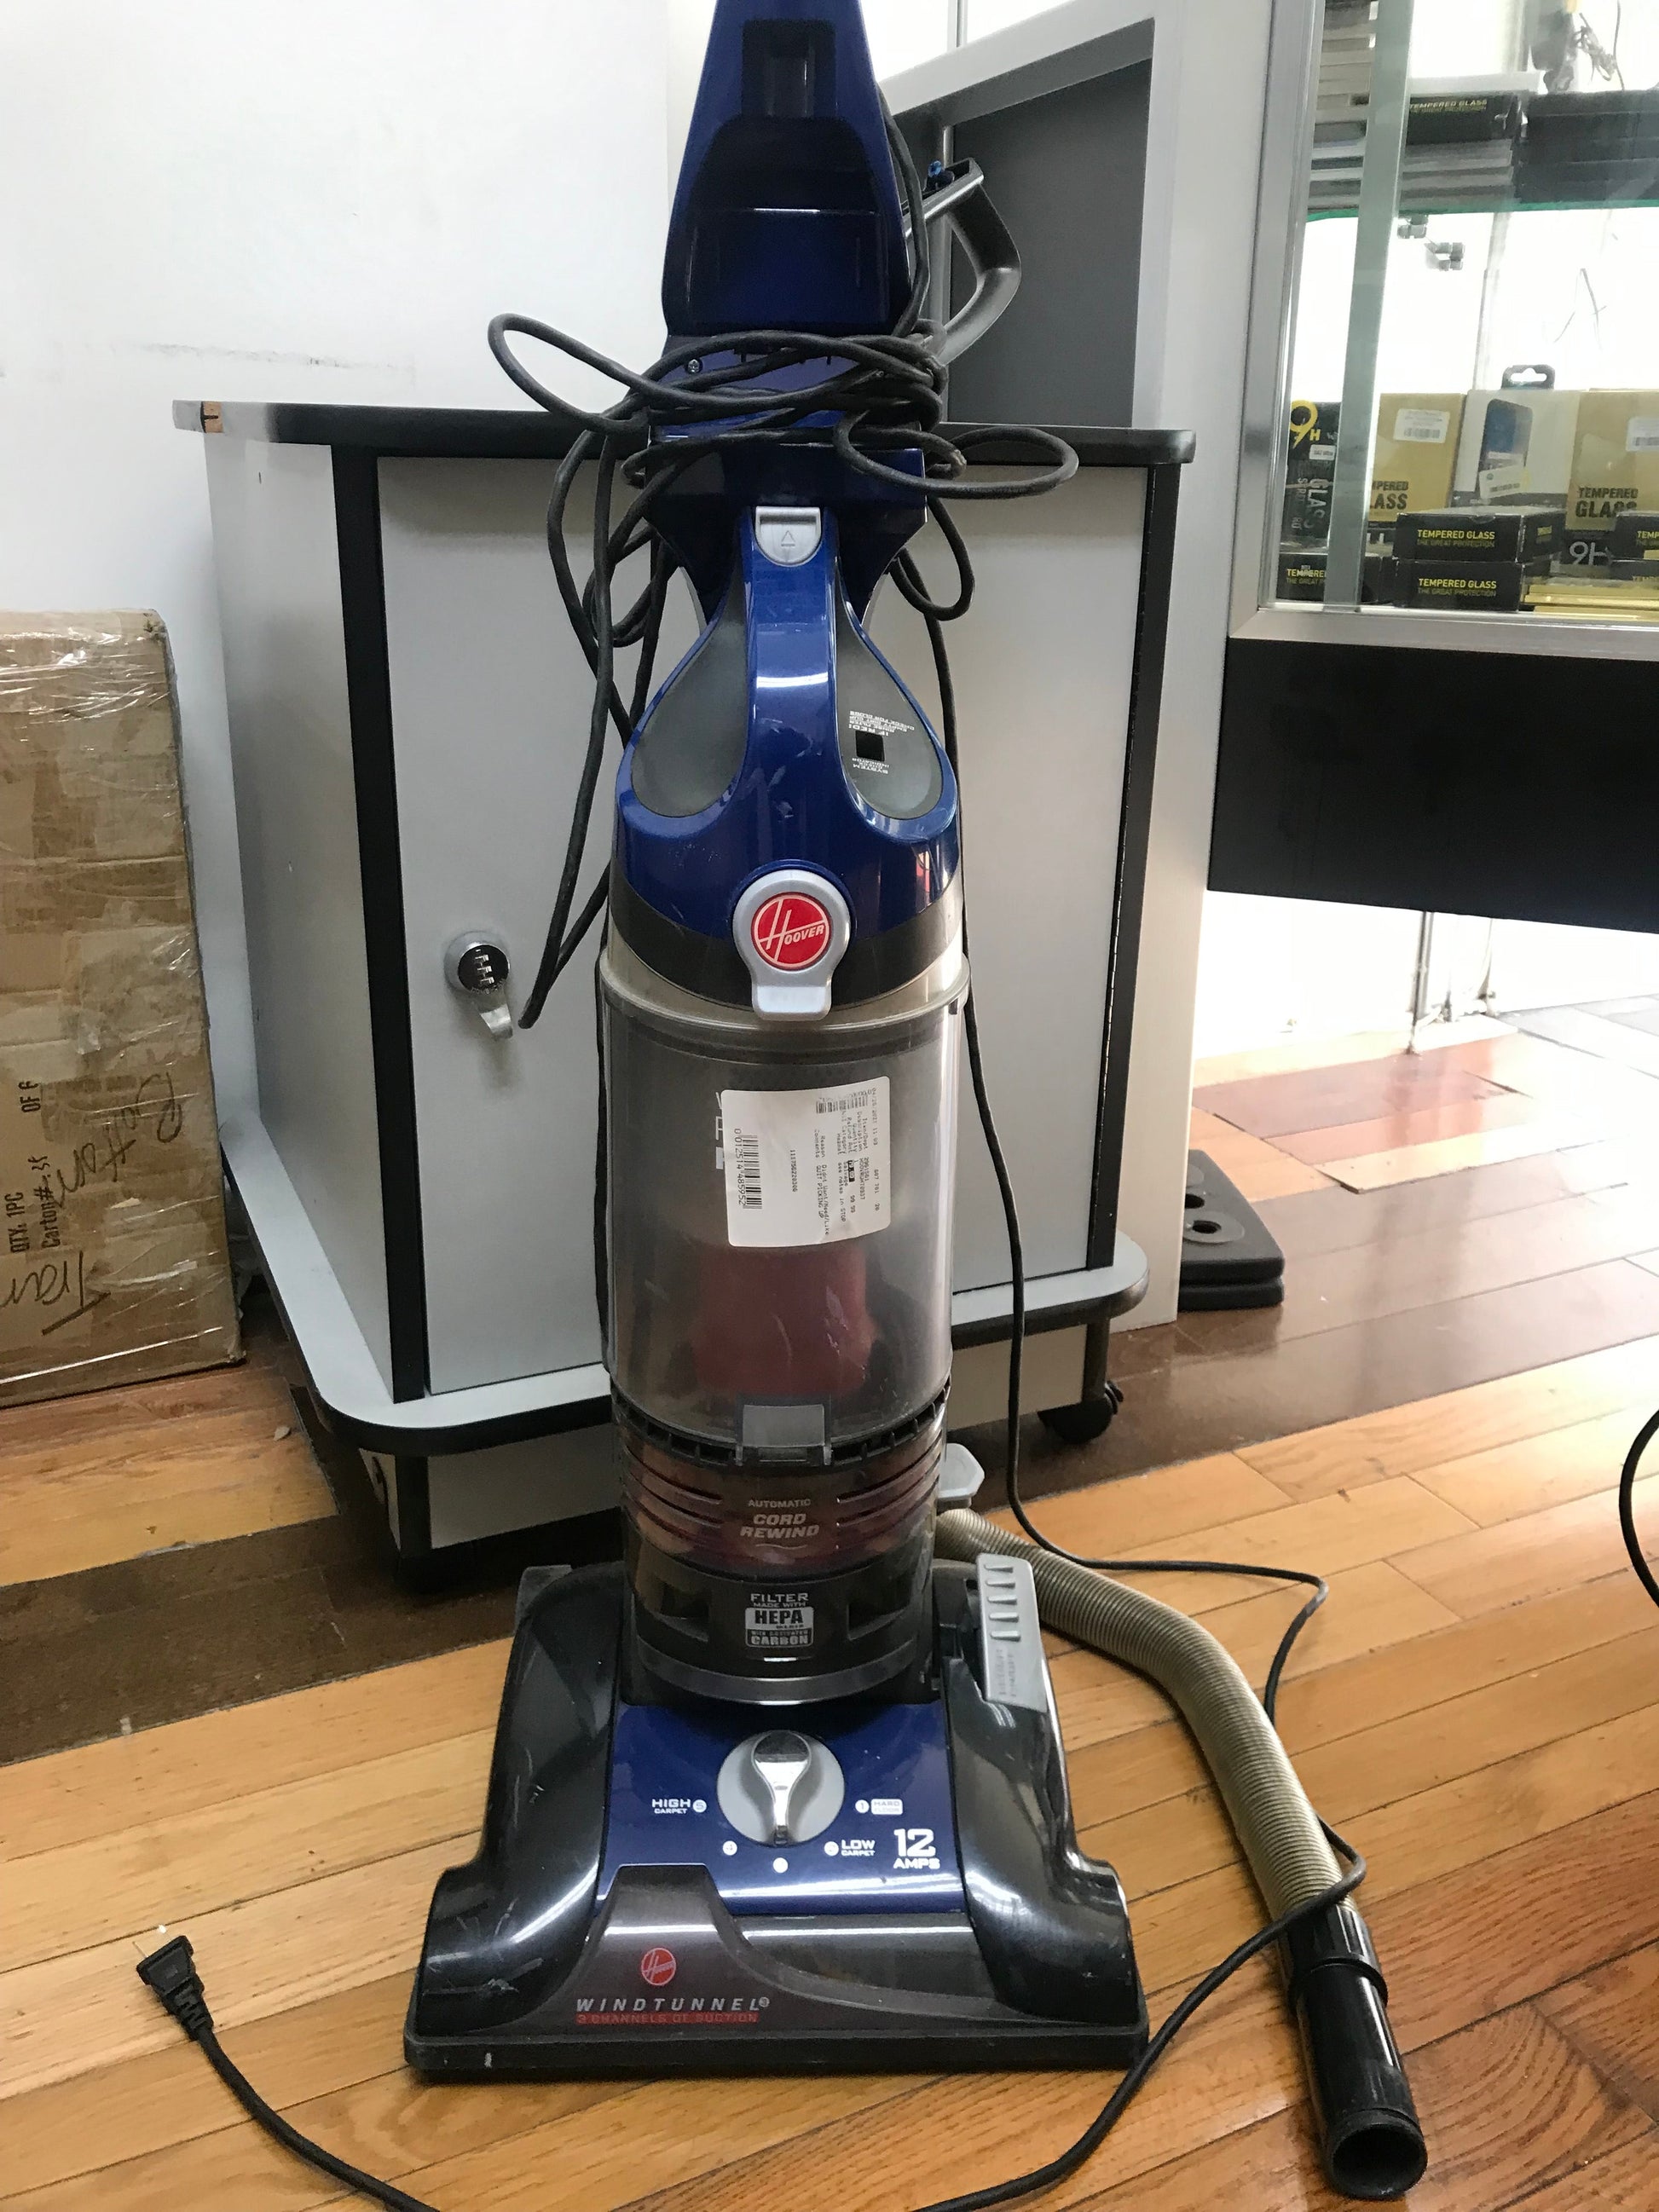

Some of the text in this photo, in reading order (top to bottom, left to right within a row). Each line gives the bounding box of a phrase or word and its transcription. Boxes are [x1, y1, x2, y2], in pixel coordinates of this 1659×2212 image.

[1372, 480, 1408, 491] PERED
[1579, 487, 1638, 499] TEMPERED
[1370, 494, 1408, 510] ASS
[1417, 529, 1495, 540] TEMPERED GLASS
[1286, 569, 1327, 578] TEMPERE
[1419, 579, 1497, 589] TEMPERED GLASS
[21, 1096, 42, 1113] OF
[5, 1192, 26, 1218] 1PC
[748, 1499, 812, 1509] AUTOMATIC
[753, 1513, 806, 1526] CORD
[739, 1525, 820, 1539] REWIND
[750, 1593, 809, 1603] FILTER
[754, 1609, 803, 1625] HEPA
[751, 1636, 808, 1645] CARBON
[651, 1799, 691, 1808] HIGH
[841, 1839, 876, 1850] LOW
[893, 1828, 936, 1857] 12
[893, 1857, 940, 1869] AMPS
[592, 2013, 667, 2024] CHANNELS
[673, 2013, 691, 2024] OF
[695, 2013, 758, 2024] SUCTION
